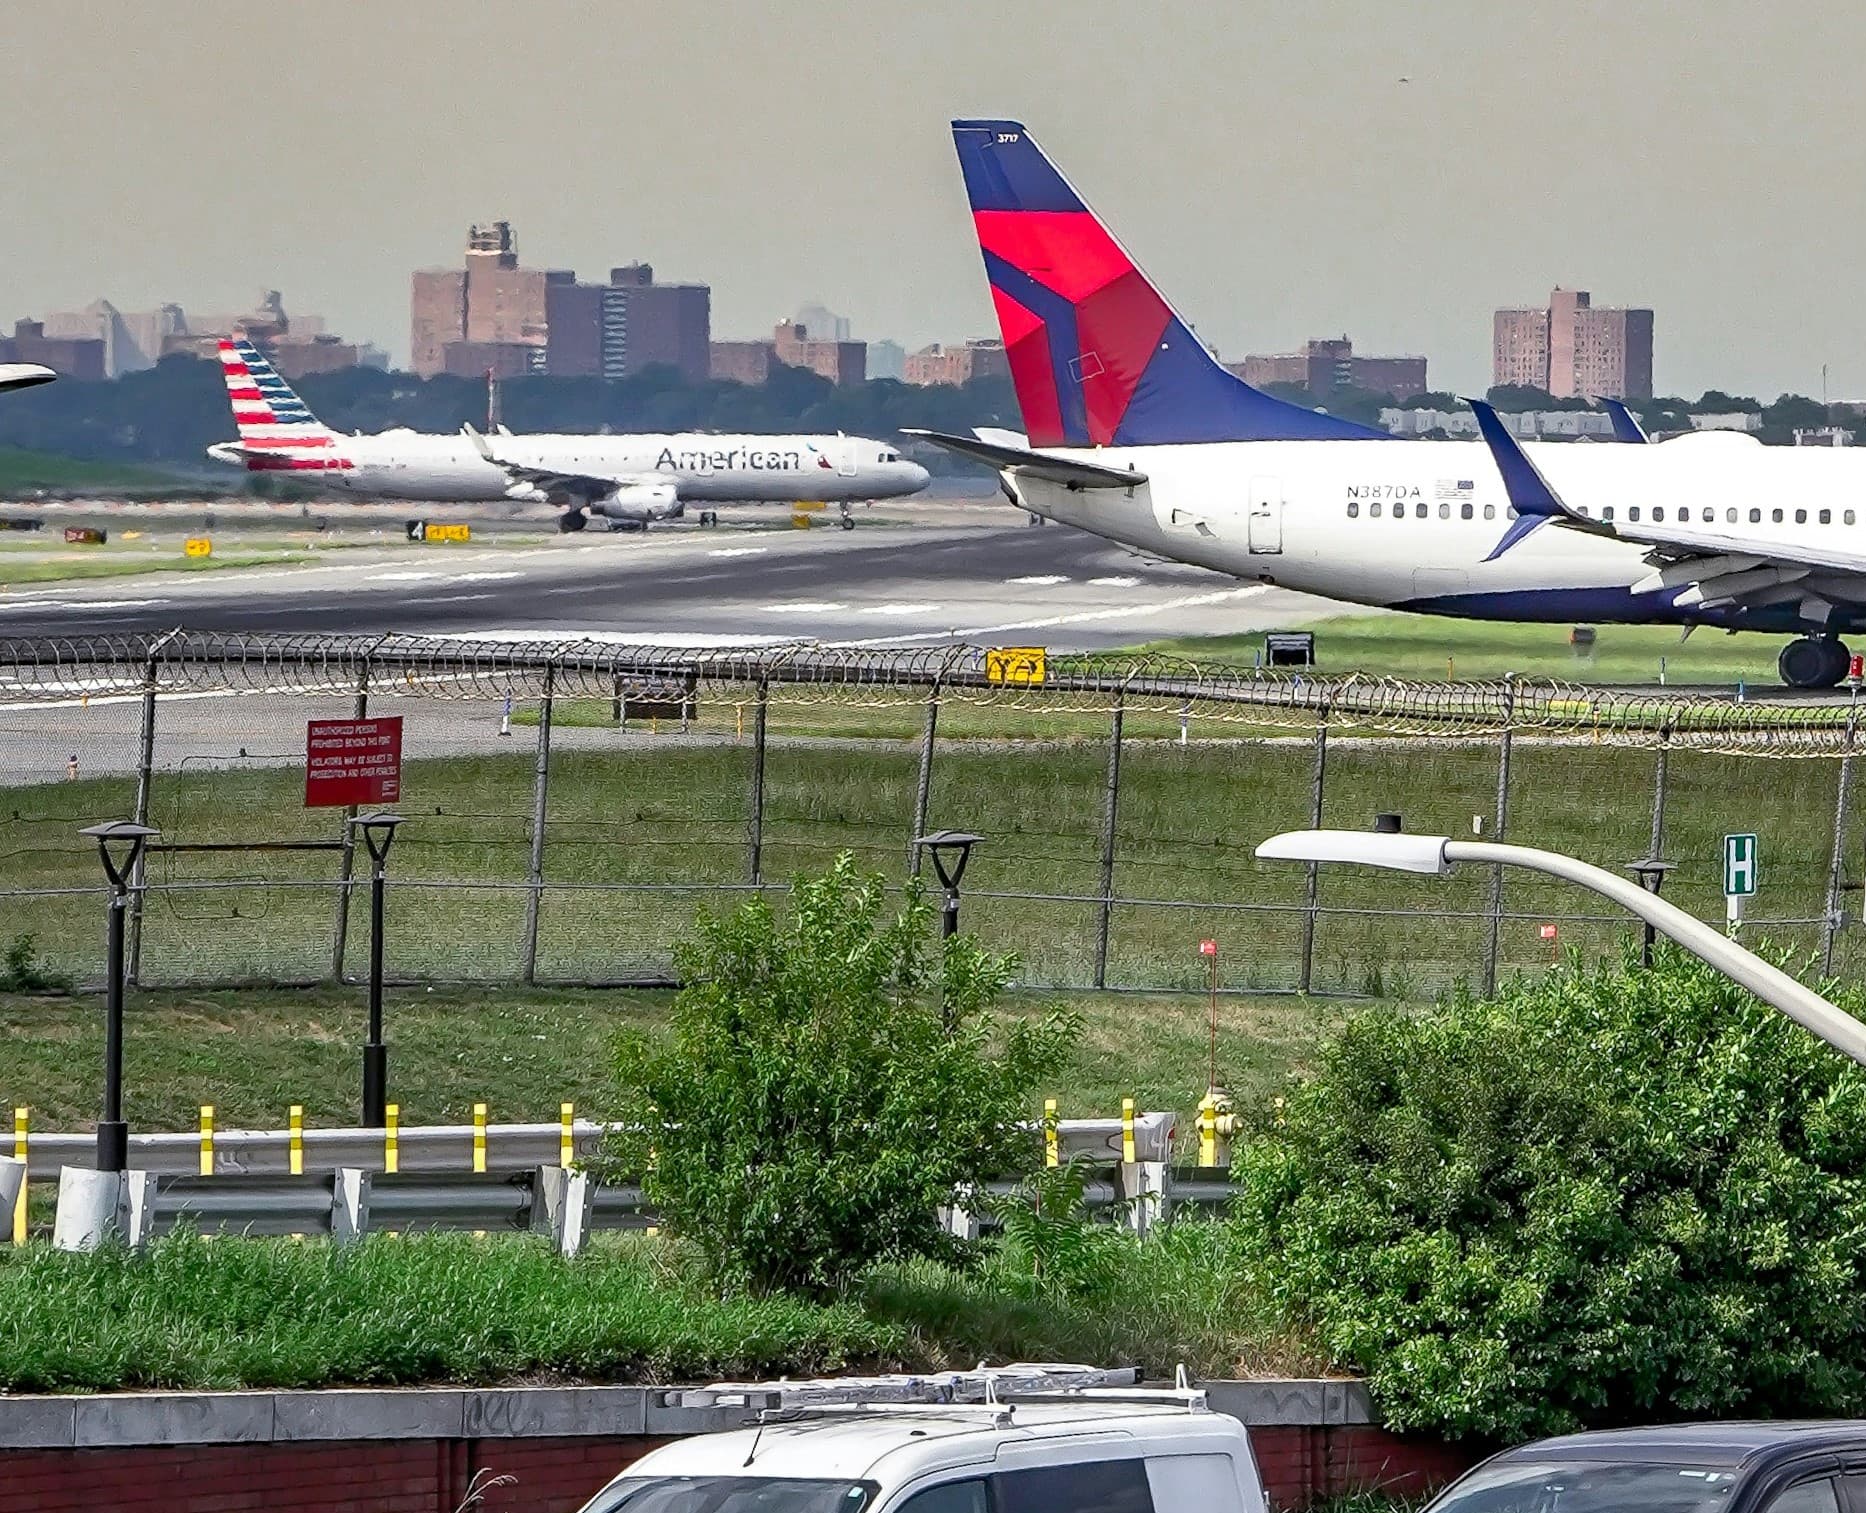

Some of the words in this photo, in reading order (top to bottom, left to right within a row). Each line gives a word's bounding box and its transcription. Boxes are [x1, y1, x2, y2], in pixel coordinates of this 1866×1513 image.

[997, 133, 1018, 143] 3717
[654, 445, 800, 471] American
[1346, 485, 1422, 499] N387DA
[1728, 838, 1753, 893] H
